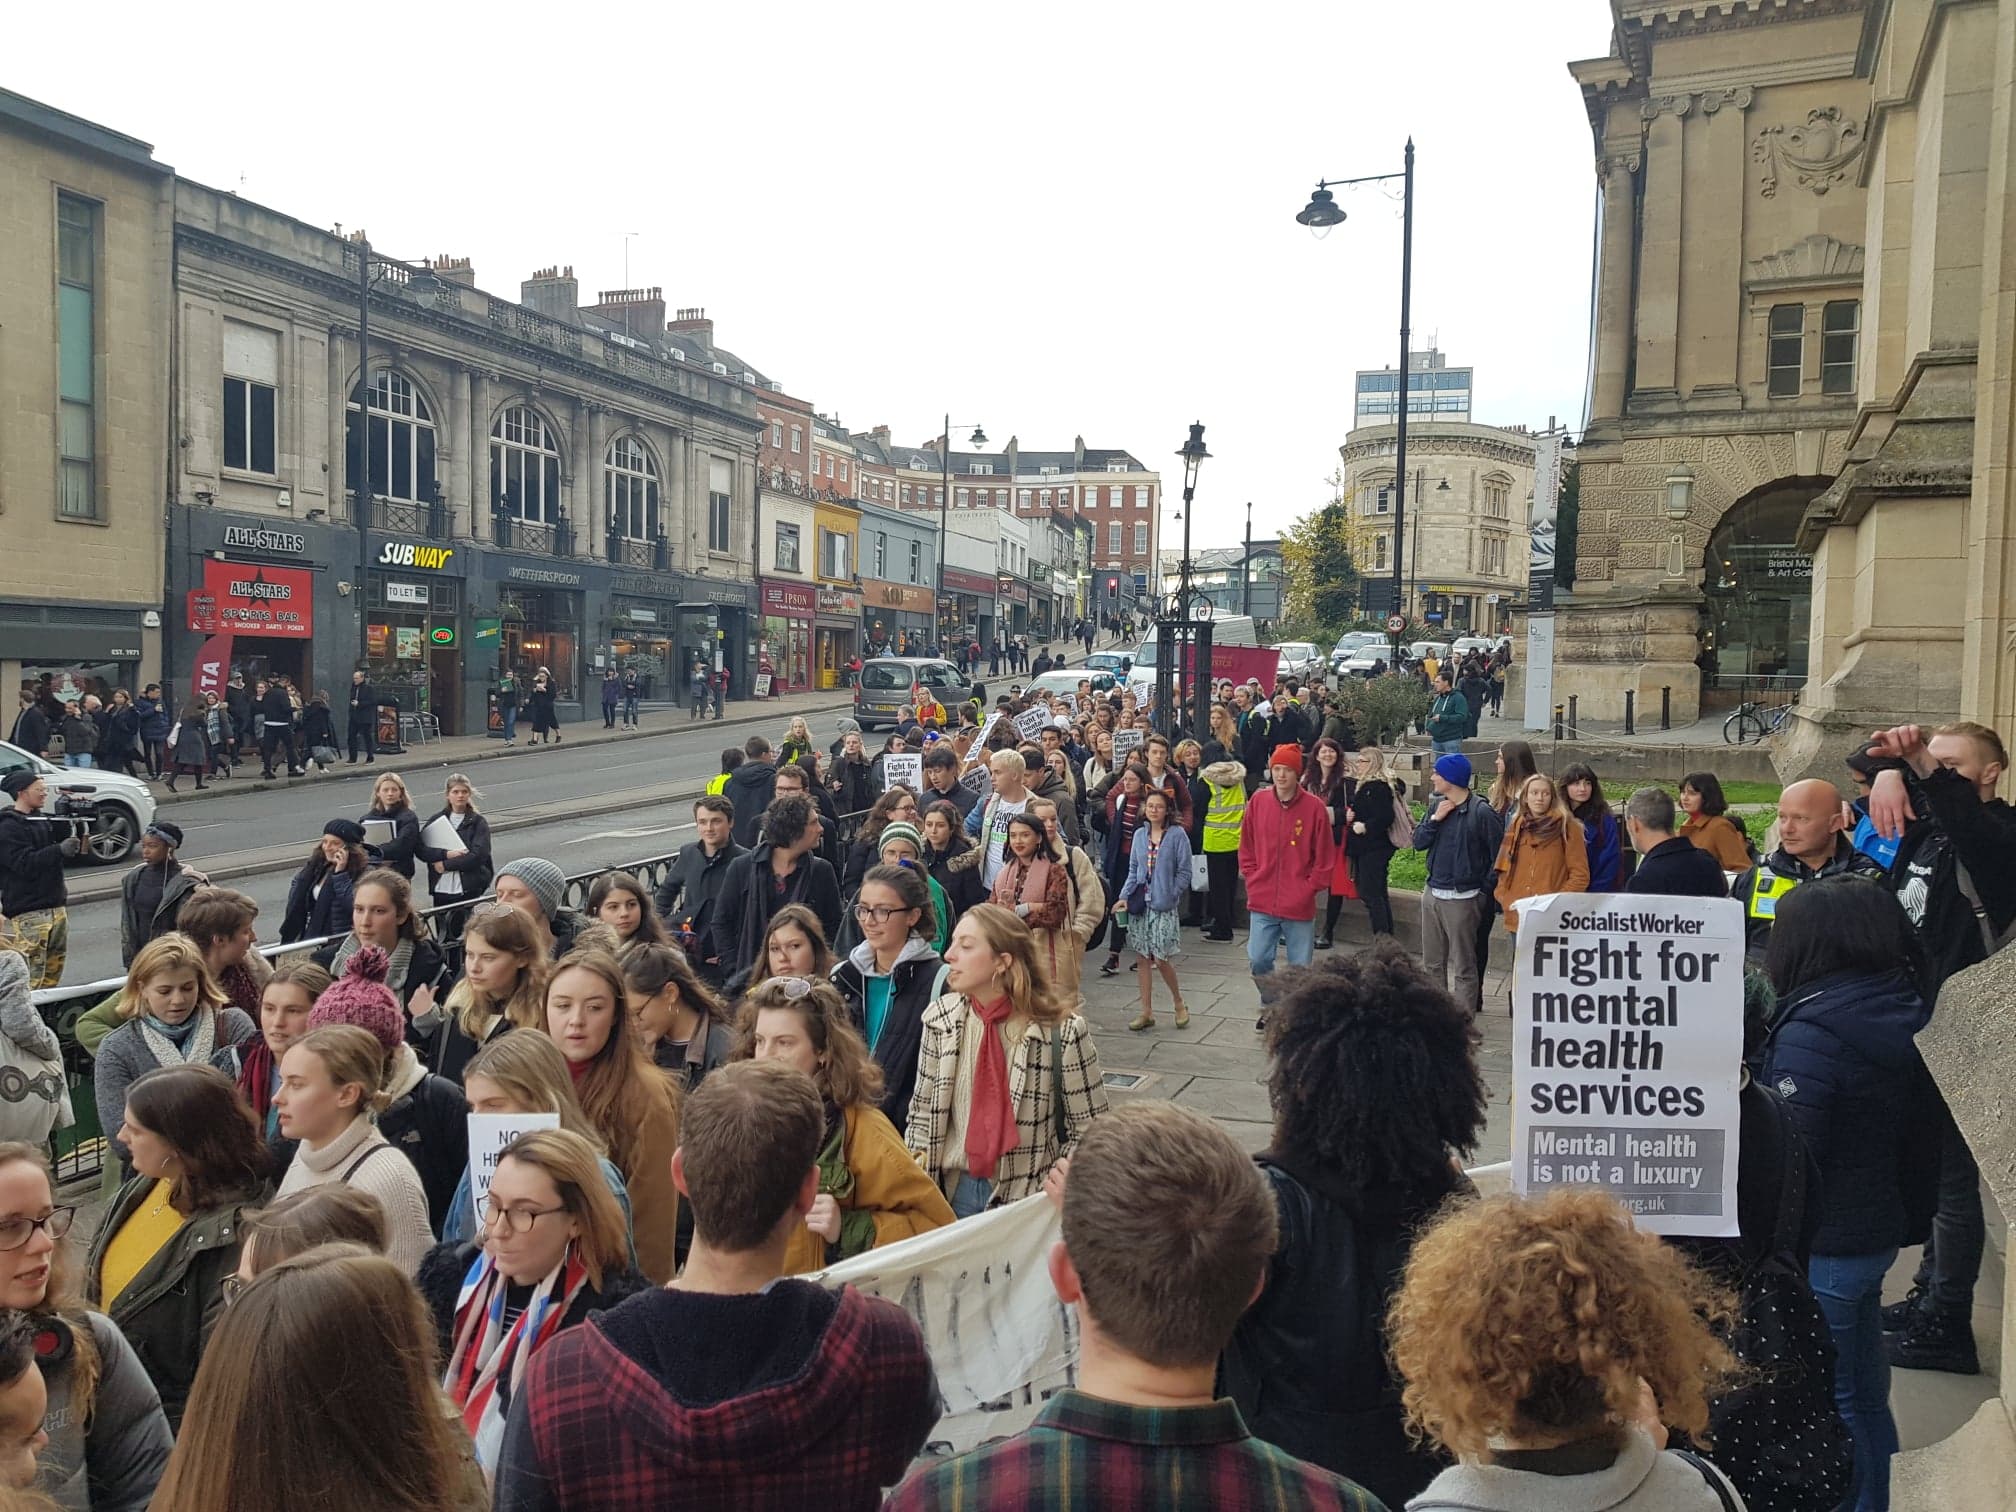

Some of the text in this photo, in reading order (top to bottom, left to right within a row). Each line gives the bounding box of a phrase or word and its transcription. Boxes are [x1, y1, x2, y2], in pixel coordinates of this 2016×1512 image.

[225, 527, 304, 552] ALL STARS
[379, 542, 453, 569] SUBWAY
[1768, 559, 1794, 568] Bristol
[508, 567, 581, 585] WETHERSPOON
[1768, 569, 1776, 577] &
[1777, 569, 1791, 577] Art
[230, 580, 291, 600] ALL STARS
[389, 586, 414, 597] TO LET
[222, 607, 299, 621] SPORTS BAR
[1389, 619, 1402, 628] 20
[887, 762, 918, 772] Fight for
[888, 770, 912, 778] mental
[978, 772, 988, 782] for
[1533, 936, 1719, 987] Fight for
[1532, 986, 1678, 1026] mental
[1531, 1026, 1663, 1070] health
[1530, 1074, 1705, 1117] services
[1534, 1131, 1697, 1158] Mental health
[1533, 1161, 1703, 1188] is not a luxury
[1619, 1195, 1665, 1214] org.uk
